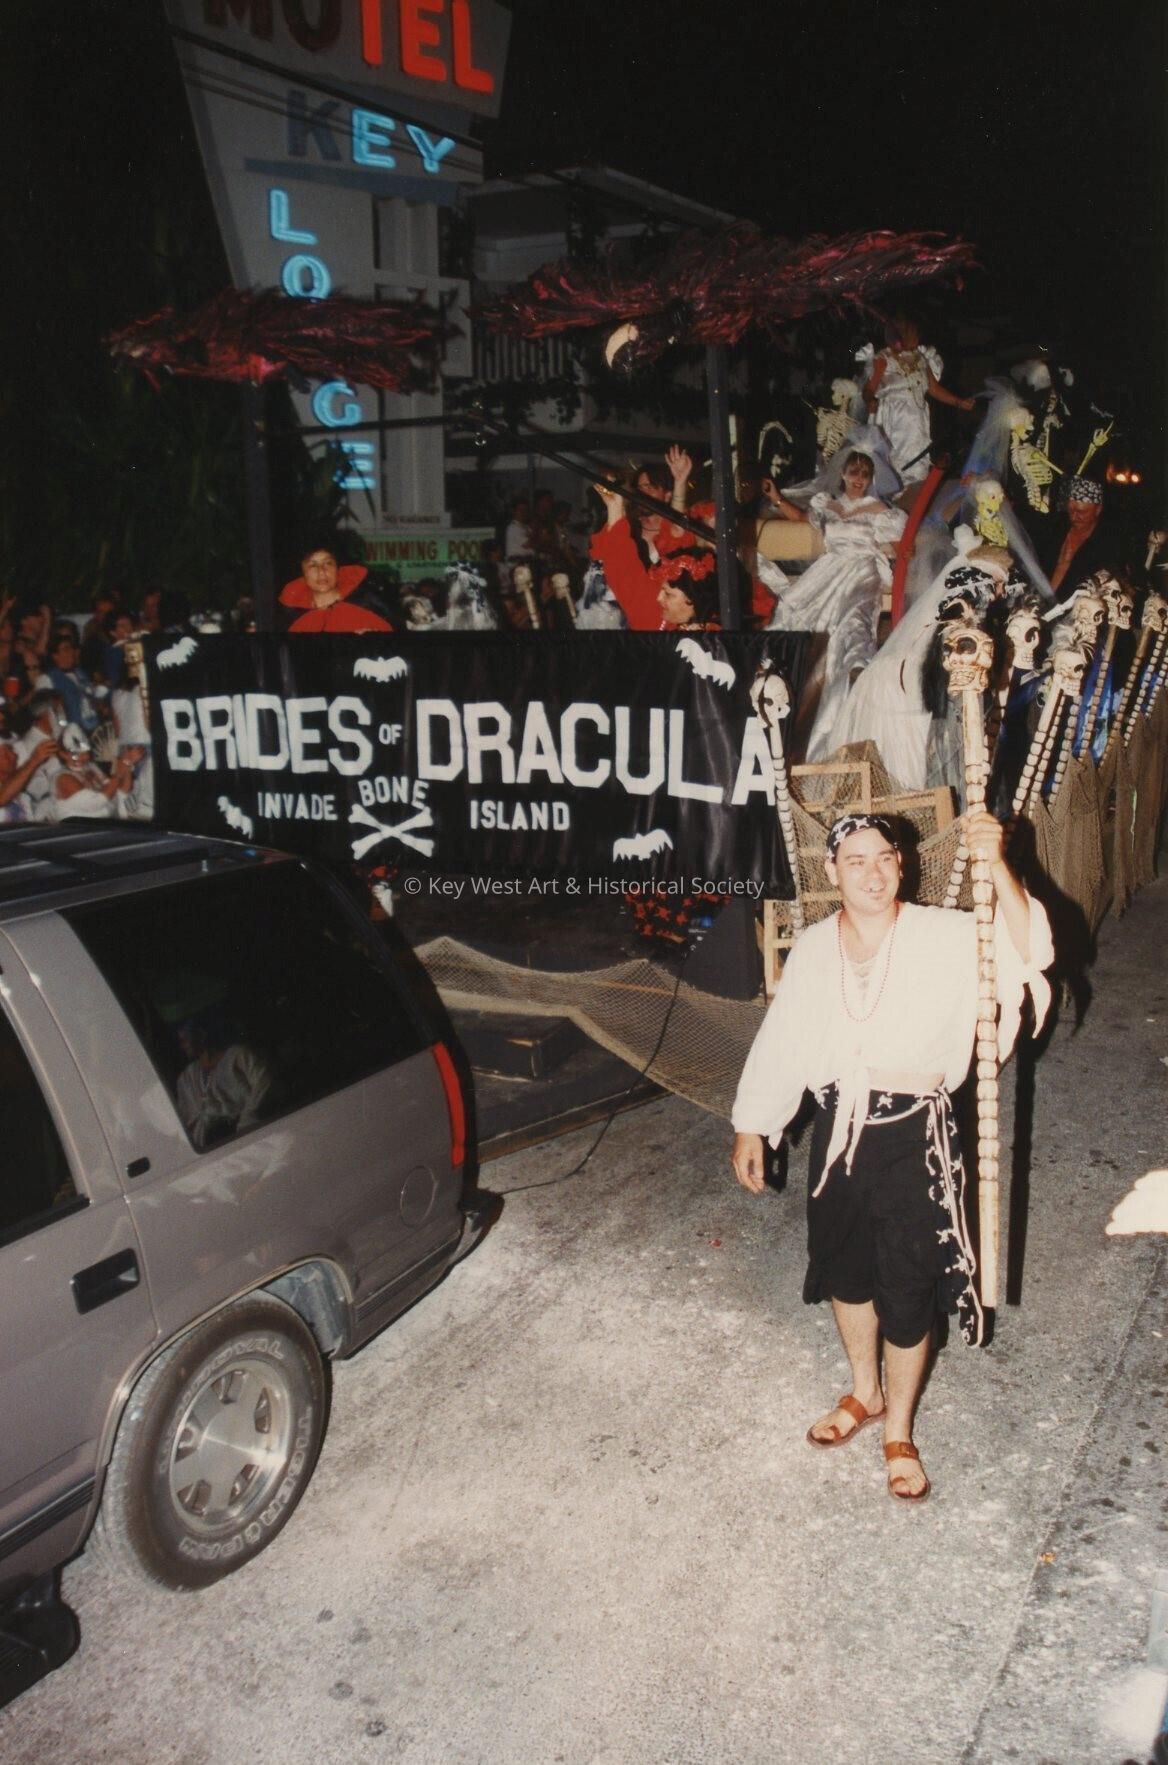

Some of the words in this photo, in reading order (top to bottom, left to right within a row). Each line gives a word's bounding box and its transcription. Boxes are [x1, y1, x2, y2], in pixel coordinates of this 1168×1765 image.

[288, 90, 456, 174] KEY
[270, 188, 376, 490] LOGE
[364, 540, 438, 561] WIMMING
[160, 693, 373, 776] BRIDES
[379, 724, 402, 744] OF
[416, 699, 777, 806] DRACULA
[258, 792, 338, 821] INVADE
[358, 776, 429, 810] BONE
[470, 800, 570, 831] ISLAND
